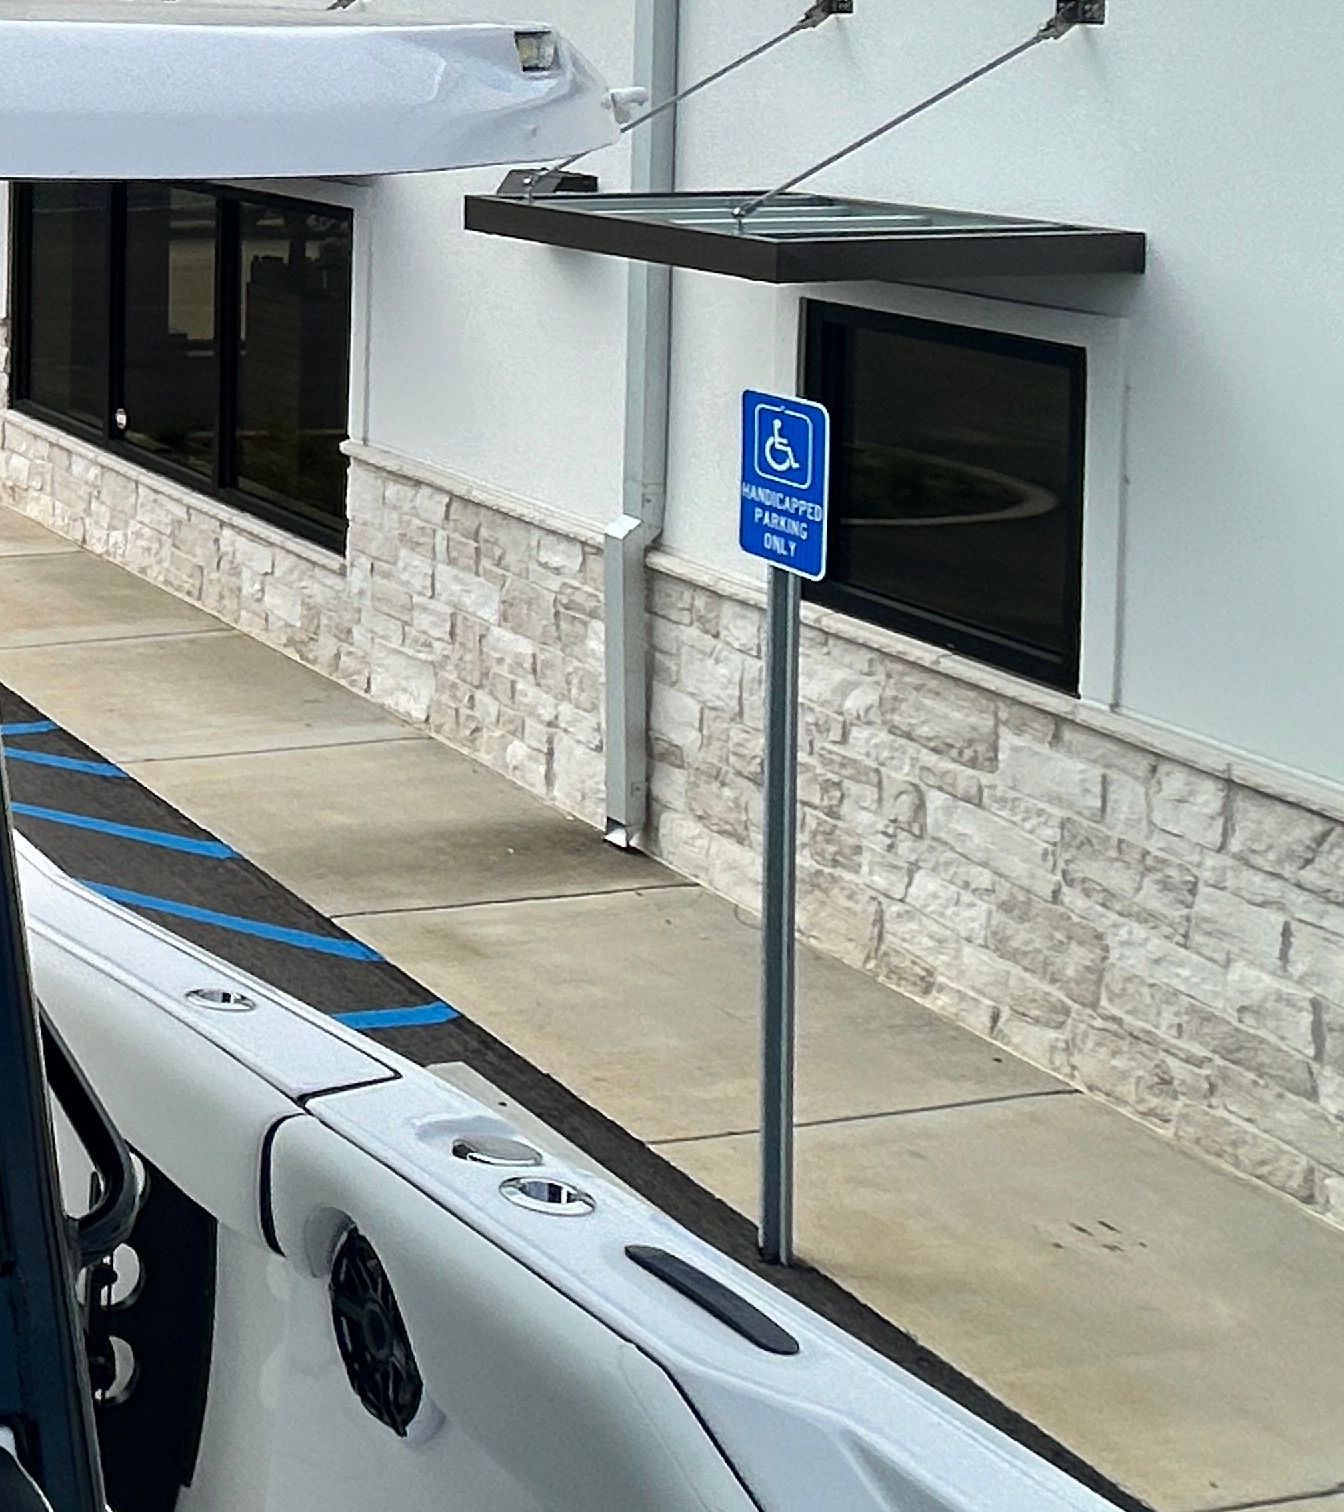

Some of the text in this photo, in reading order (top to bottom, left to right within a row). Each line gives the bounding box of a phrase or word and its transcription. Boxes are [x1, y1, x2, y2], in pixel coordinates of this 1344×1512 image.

[741, 481, 823, 522] HANDICAPPED
[754, 507, 808, 540] PARKING
[764, 532, 797, 558] ONLY
